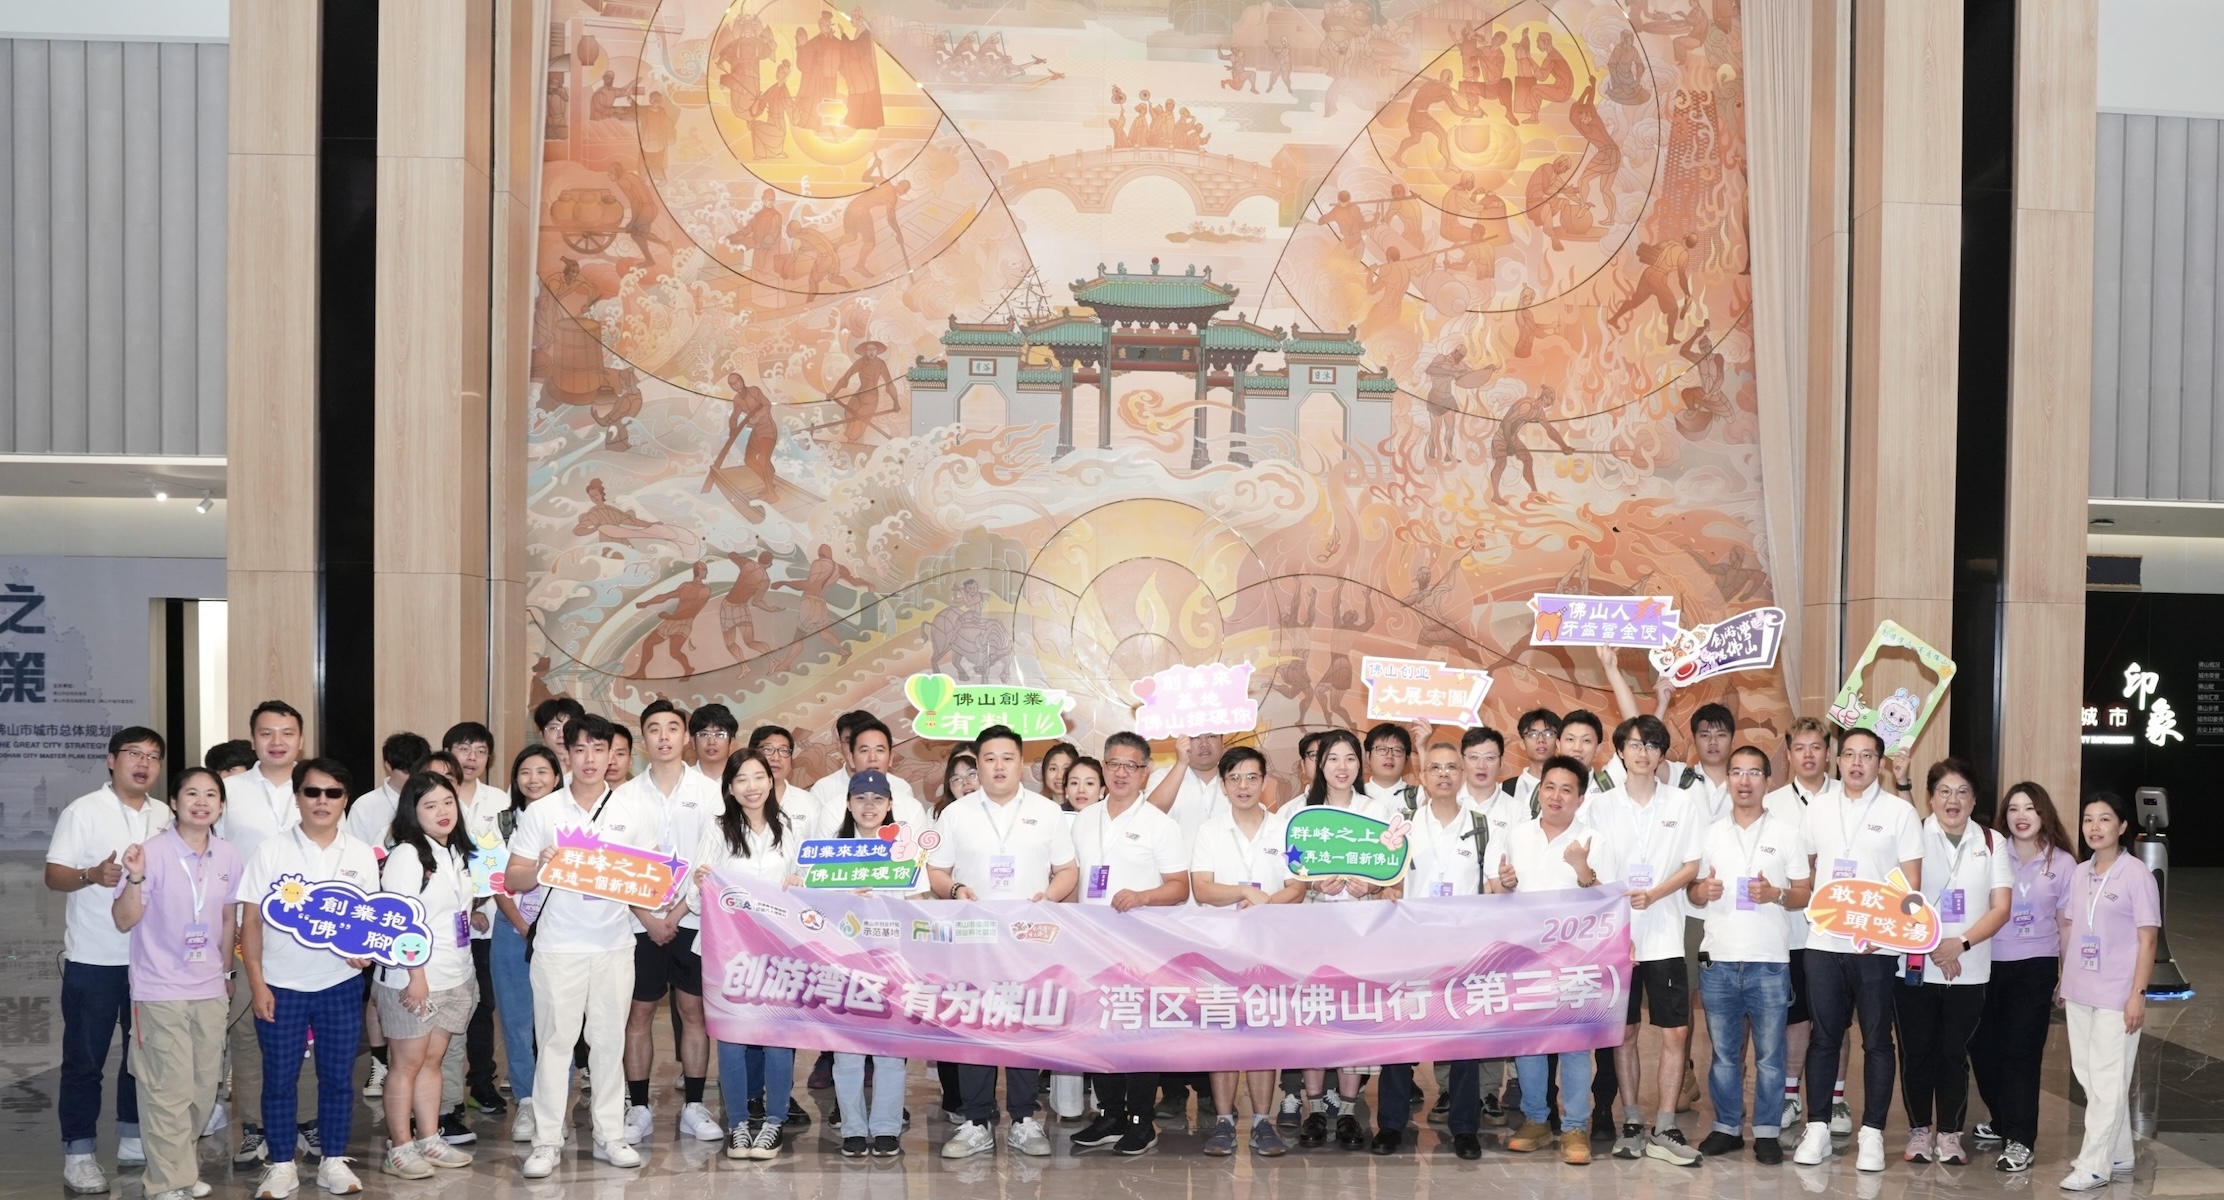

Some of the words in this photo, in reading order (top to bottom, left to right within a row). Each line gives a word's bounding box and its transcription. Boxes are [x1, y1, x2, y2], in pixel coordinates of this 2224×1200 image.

[1569, 601, 1631, 621] 佛山人
[1369, 664, 1430, 679] 佛山创业
[953, 692, 1043, 706] 佛山創業
[1175, 690, 1222, 709] 基地
[1379, 685, 1468, 707] 大展宏圖
[2081, 707, 2128, 727] 城市
[2123, 662, 2184, 747] 印象
[43, 741, 62, 749] CITY
[1290, 826, 1379, 844] 群峰之上
[801, 844, 888, 858] 創業來基地
[1304, 850, 1399, 866] 再造一個新佛山
[560, 849, 662, 882] 群峰之上
[549, 868, 651, 898] 再造一個新佛山
[1828, 884, 1885, 910] 敢飲
[319, 896, 407, 931] 創業抱
[863, 927, 900, 937] 示范基地
[1539, 912, 1617, 945] 2025
[1843, 910, 1930, 942] 頭啖湯
[721, 951, 890, 1014] 创游湾区
[901, 979, 1069, 1027] 有为佛山
